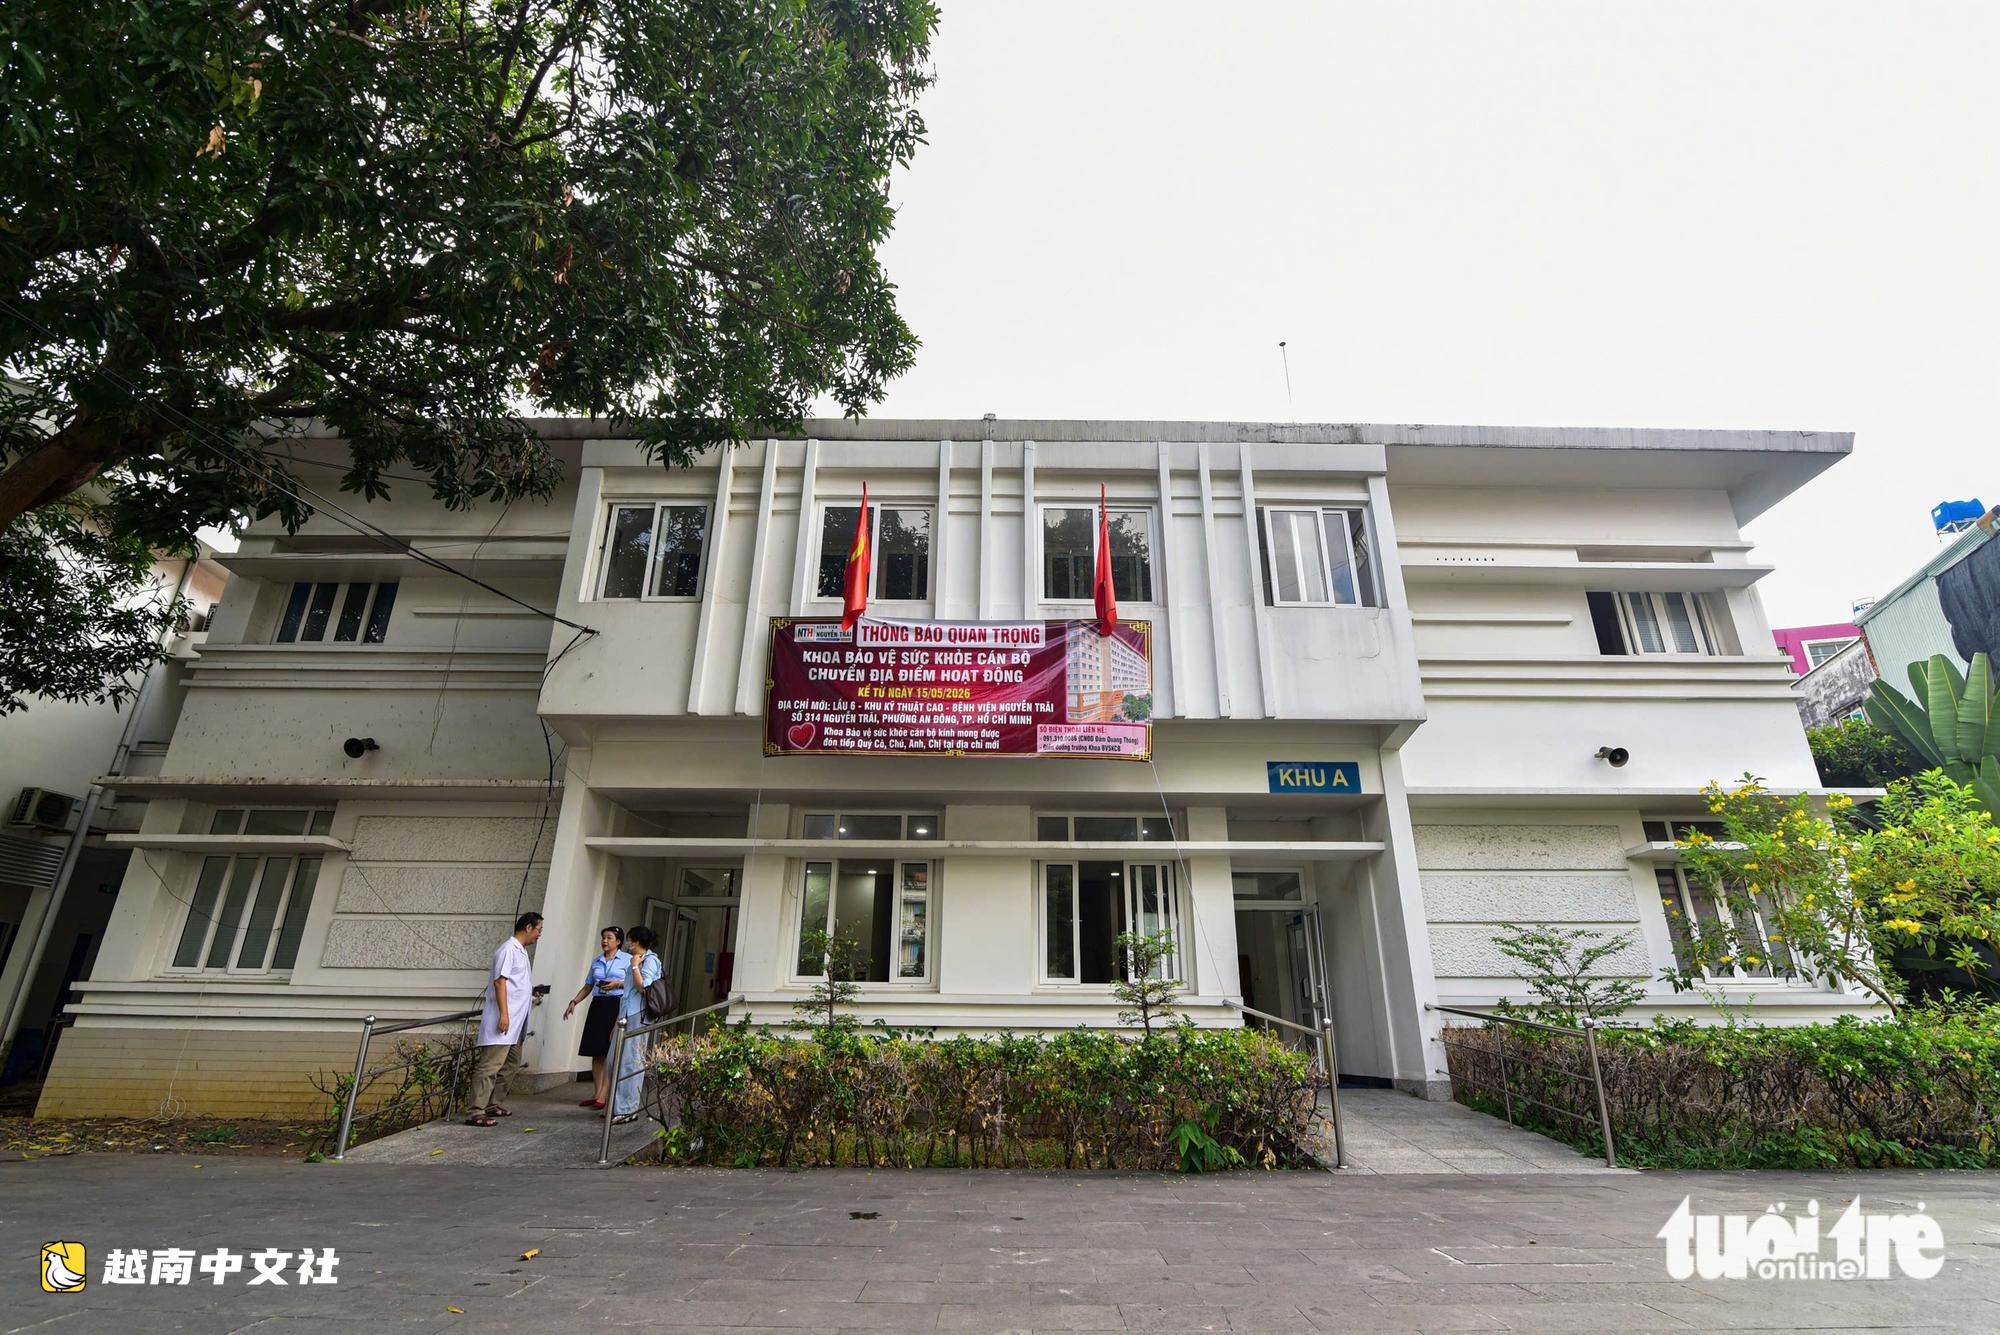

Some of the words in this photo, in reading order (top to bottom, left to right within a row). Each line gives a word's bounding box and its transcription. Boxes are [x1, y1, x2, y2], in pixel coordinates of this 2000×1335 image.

[798, 628, 813, 637] NTH
[862, 623, 908, 642] THÔNG
[914, 624, 943, 642] BÁO
[948, 627, 987, 644] QUAN
[992, 627, 1040, 647] TRỌNG
[803, 651, 840, 664] KHOA
[845, 648, 874, 664] BẢO
[879, 649, 896, 667] VỆ
[901, 649, 929, 665] SỨC
[934, 648, 972, 665] KHỎE
[977, 650, 1005, 665] CÁN
[1011, 650, 1031, 668] BỘ
[809, 664, 865, 681] CHUYỂN
[869, 669, 894, 685] ĐỊA
[898, 665, 935, 682] ĐIỂM
[940, 669, 979, 685] HOẠT
[983, 667, 1024, 686] ĐỘNG
[888, 685, 912, 698] NGÀY
[917, 687, 971, 699] 15/05/2026
[778, 700, 791, 711] ĐỊA
[794, 698, 808, 710] CHỈ
[811, 699, 830, 711] MỚI:
[850, 701, 856, 710] 6
[864, 701, 881, 710] KHU
[884, 700, 894, 711] KỸ
[897, 701, 924, 713] THUẬT
[926, 702, 943, 712] CAO
[952, 702, 974, 713] BỆNH
[977, 702, 996, 713] VIỆN
[1000, 699, 1032, 712] NGUYỄN
[791, 710, 803, 722] SỐ
[804, 713, 820, 722] 314
[823, 711, 856, 723] NGUYỄN
[882, 713, 917, 723] PHƯỜNG
[919, 714, 931, 723] AN
[933, 713, 959, 725] ĐÔNG,
[961, 715, 975, 724] TP.
[977, 712, 989, 724] HỒ
[992, 713, 1007, 724] CHÍ
[1009, 715, 1032, 724] MINH
[824, 727, 843, 736] Khoa
[846, 727, 860, 737] Bảo
[863, 728, 872, 738] vệ
[873, 728, 887, 737] sức
[889, 728, 908, 737] khỏe
[910, 728, 924, 737] cán
[926, 728, 936, 739] bộ
[938, 728, 955, 737] kính
[957, 730, 978, 739] mong
[981, 728, 1000, 740] được
[823, 738, 837, 747] đón
[840, 738, 855, 749] tiếp
[857, 740, 872, 749] Quý
[874, 740, 887, 749] Cô,
[909, 740, 926, 749] Anh,
[928, 740, 941, 750] Chị
[944, 740, 954, 750] tại
[956, 740, 968, 750] địa
[985, 740, 1000, 749] mới
[1279, 768, 1326, 787] KHU
[1332, 768, 1350, 787] A
